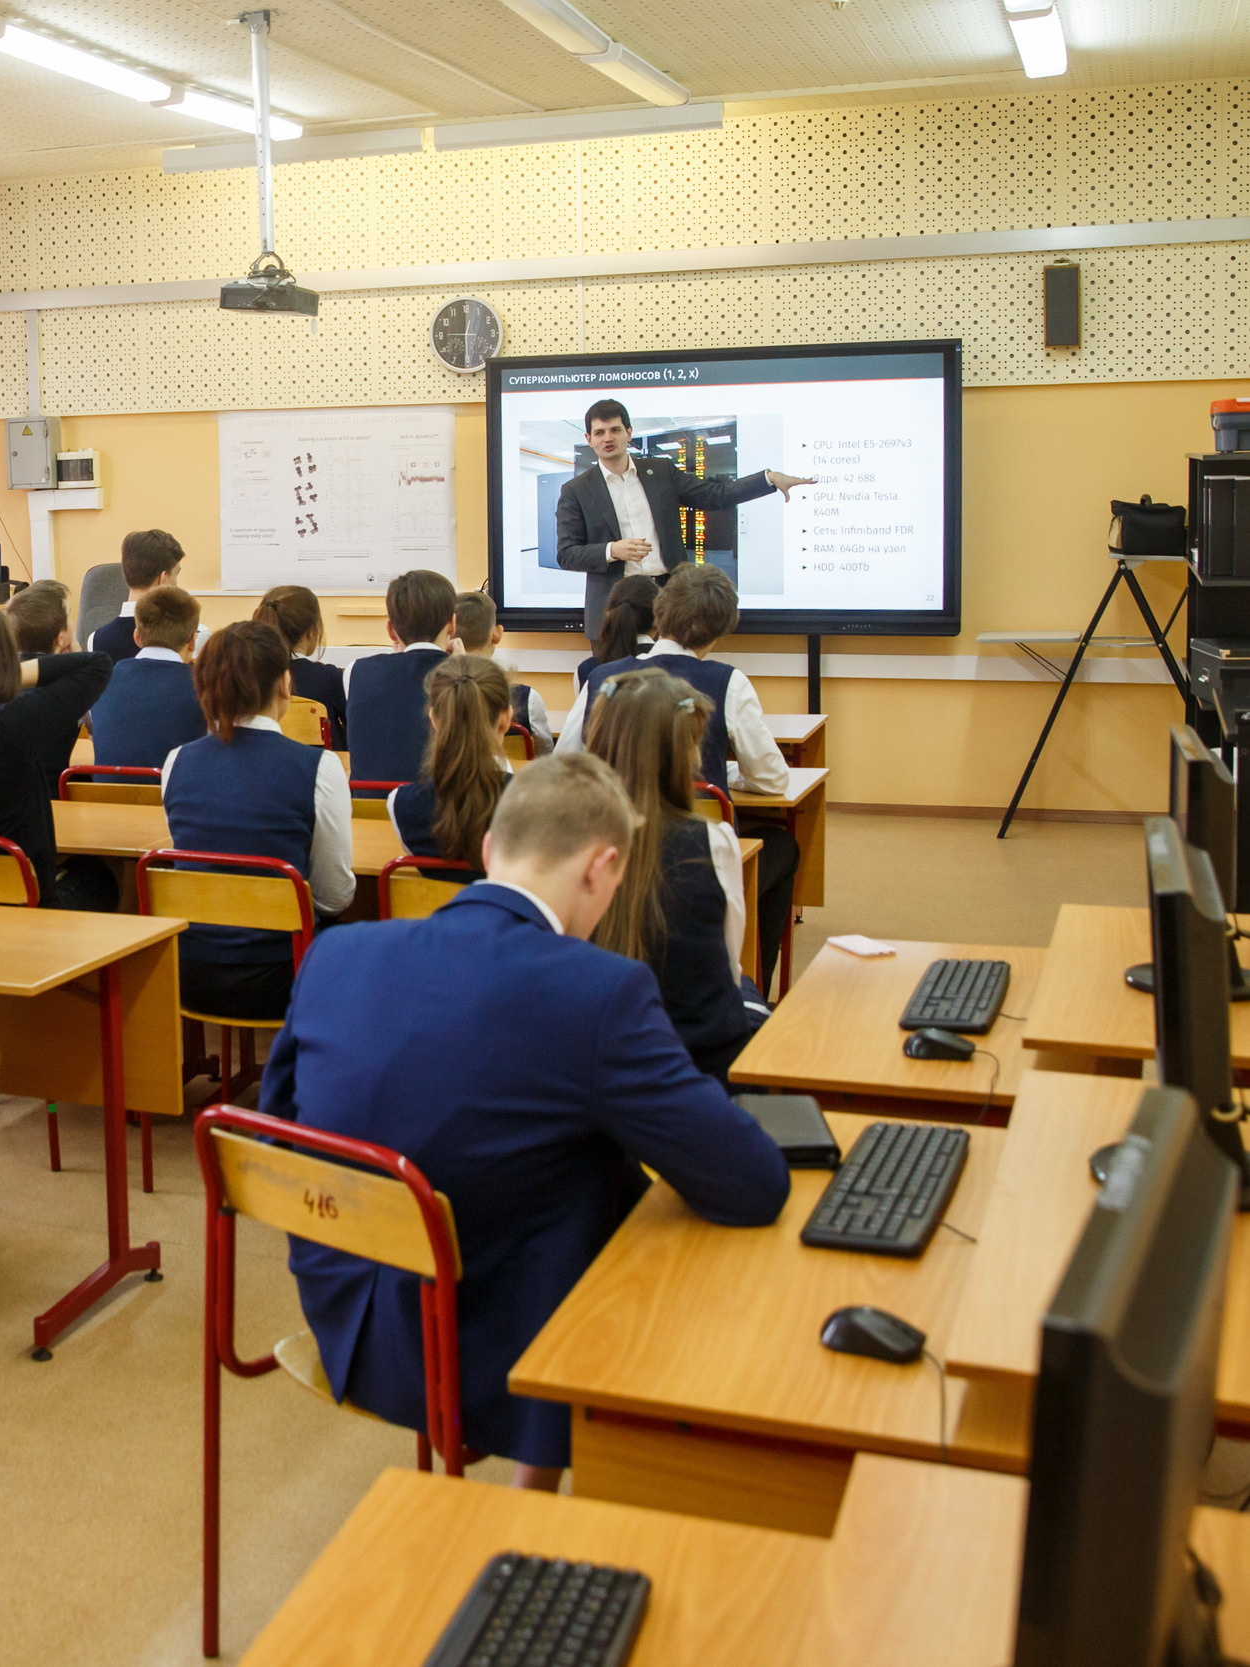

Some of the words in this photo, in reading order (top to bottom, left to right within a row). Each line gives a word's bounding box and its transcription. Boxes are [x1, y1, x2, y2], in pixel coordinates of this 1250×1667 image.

[485, 315, 491, 325] 2
[508, 374, 597, 386] СУПЕРКОМПЬЮТЕР
[598, 371, 661, 382] ЛОМОНОСОВ
[663, 368, 676, 381] (1,
[677, 368, 687, 380] 2,
[838, 439, 860, 449] Intel
[813, 454, 827, 466] (14
[830, 454, 861, 466] cores)
[843, 474, 854, 483] 42
[857, 473, 876, 483] 688
[813, 492, 836, 502] GPU:
[839, 491, 870, 501] Nvidia
[873, 491, 899, 501] Tesla
[841, 525, 891, 535] Infiniband
[895, 525, 914, 535] FDR
[813, 544, 837, 553] RAM:
[839, 544, 865, 553] 64Gb
[883, 545, 906, 555] узел
[839, 562, 870, 572] 400Tb
[303, 1188, 339, 1220] 416
